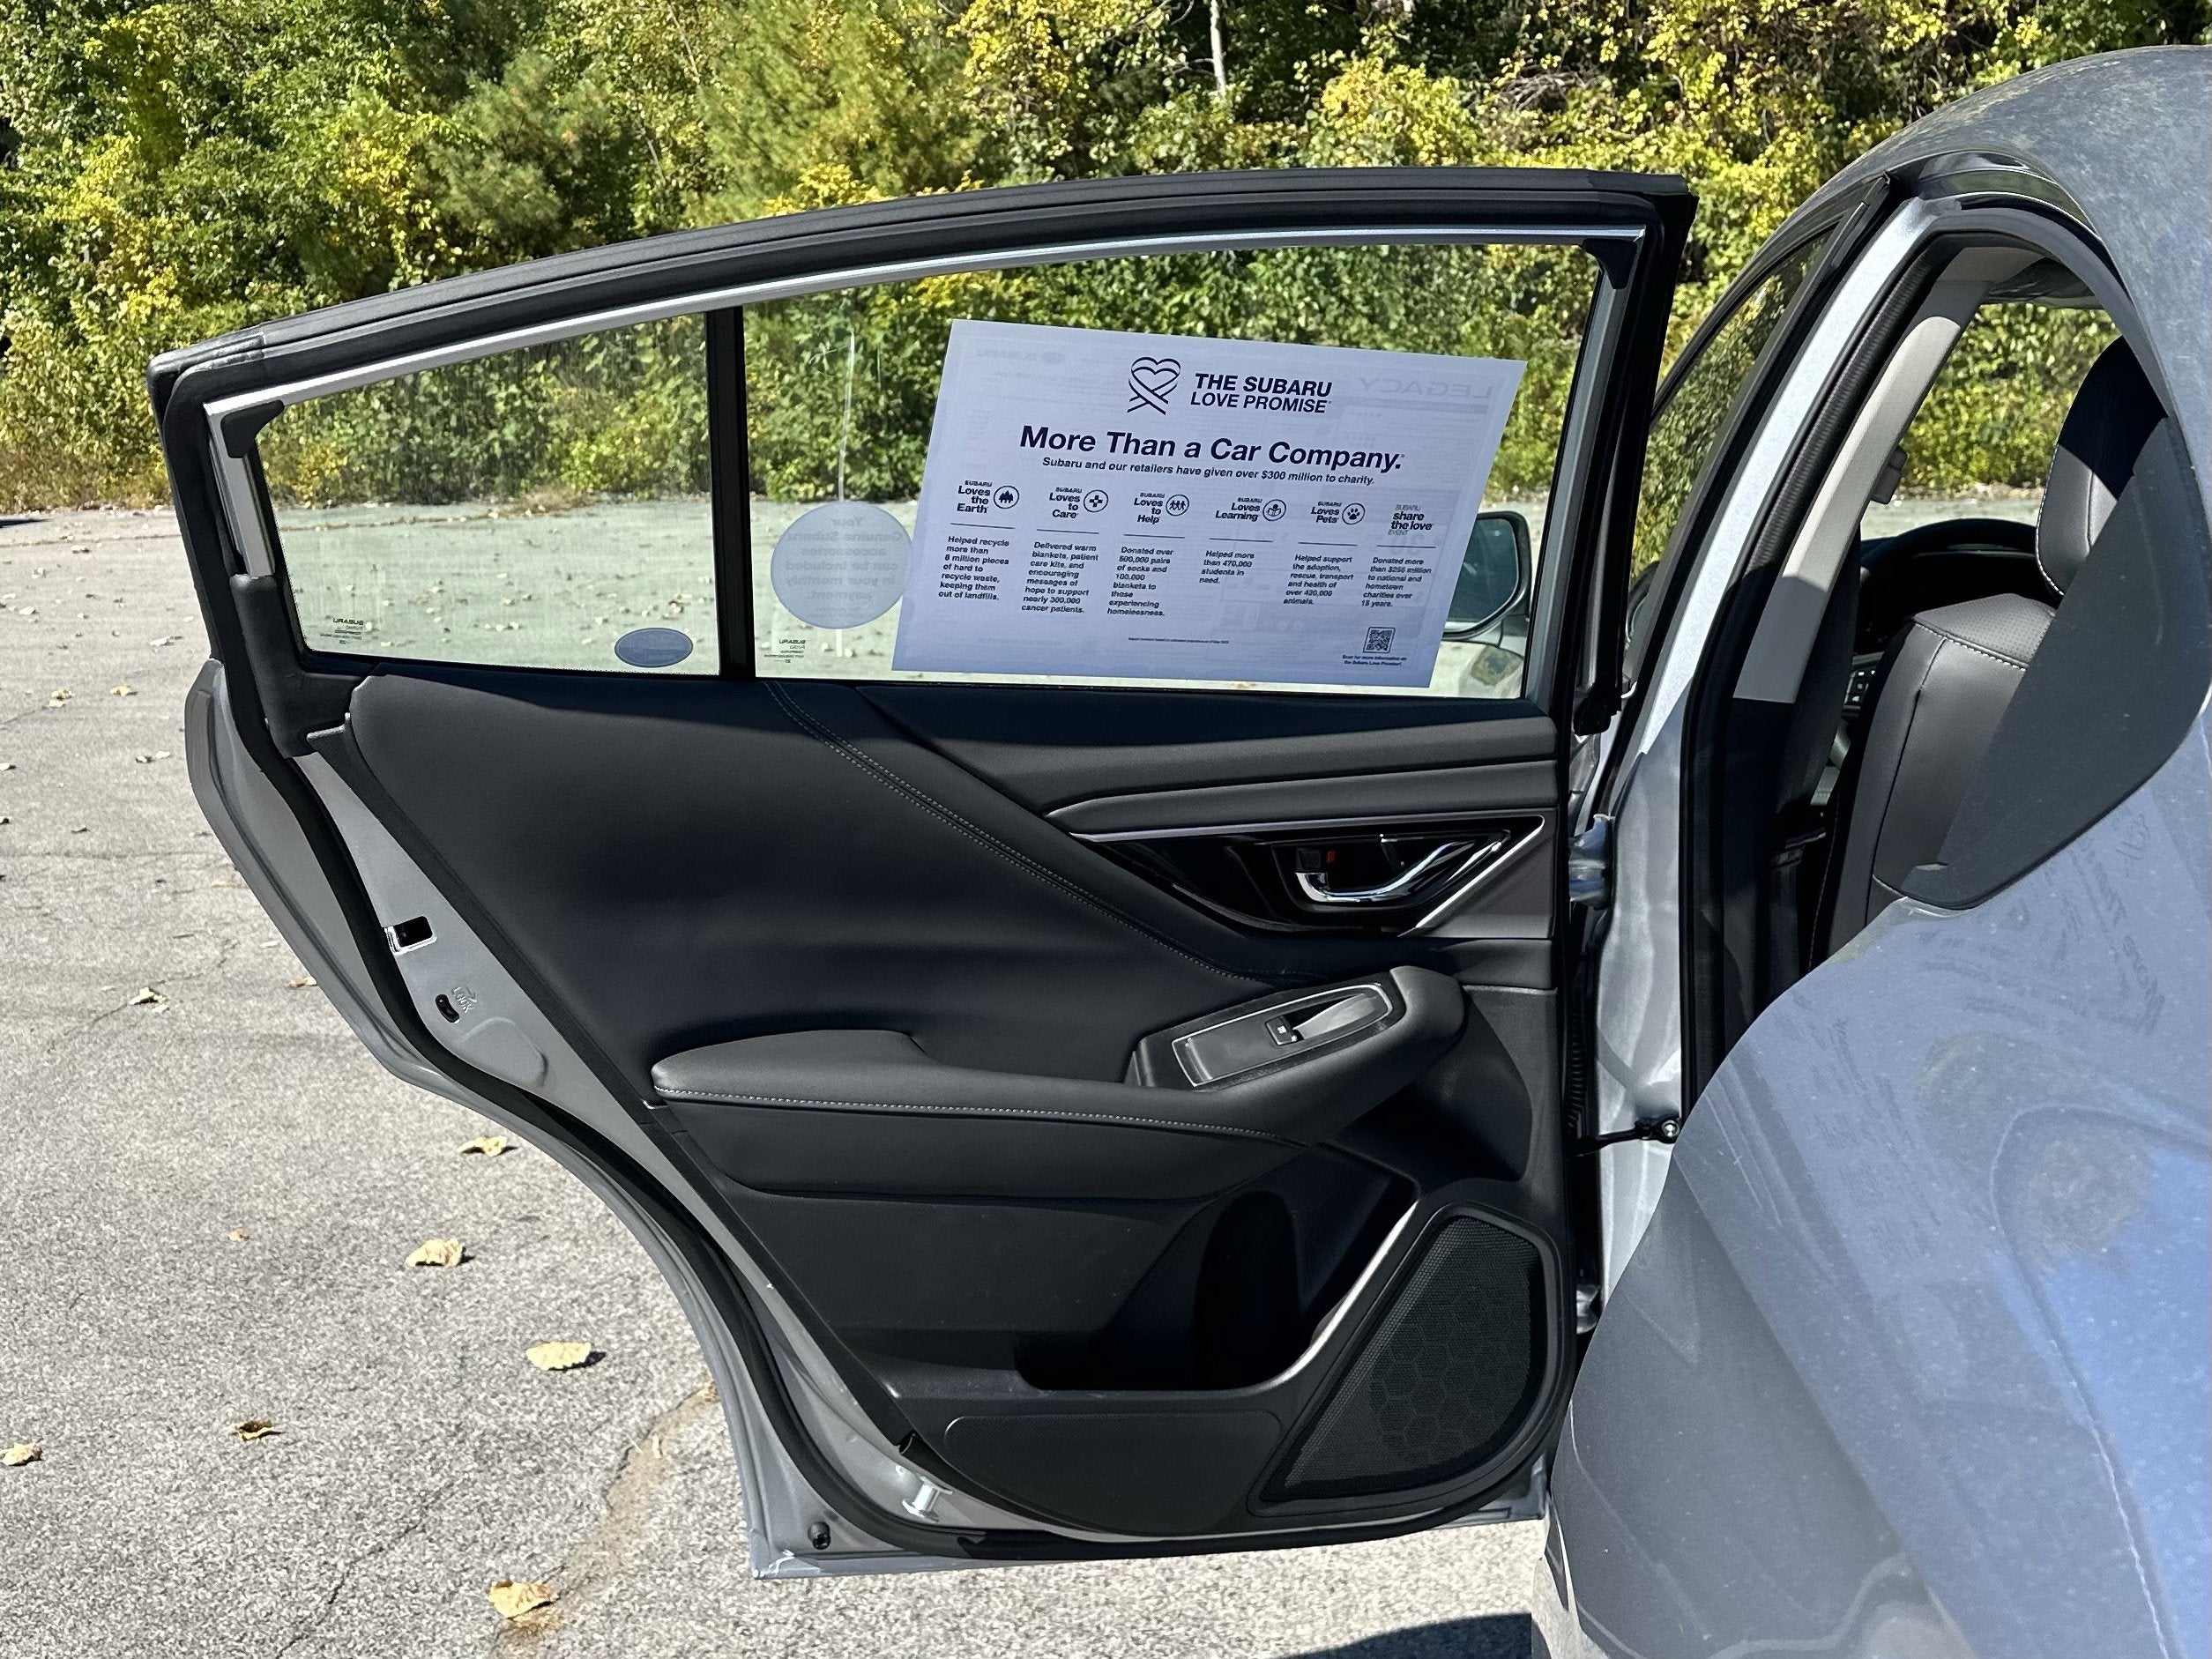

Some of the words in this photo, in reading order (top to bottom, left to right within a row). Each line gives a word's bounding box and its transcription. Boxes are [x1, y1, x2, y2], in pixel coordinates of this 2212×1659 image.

[1195, 373, 1238, 391] THE
[1243, 376, 1332, 397] SUBARU
[1190, 391, 1240, 407] LOVE
[1020, 425, 1096, 452] More
[1106, 431, 1176, 457] Than
[1184, 442, 1202, 458] a
[1210, 437, 1262, 461] Car
[1042, 457, 1082, 469] Subaru
[1085, 461, 1106, 470] and
[1109, 463, 1128, 472] our
[1130, 463, 1173, 474] retailers
[1176, 465, 1201, 475] have
[1203, 467, 1233, 478] given
[1262, 470, 1285, 480] $300
[1287, 472, 1322, 482] million
[1326, 473, 1336, 483] to
[1337, 474, 1374, 486] charity.
[958, 486, 991, 495] Loves
[972, 495, 989, 504] the
[1049, 492, 1080, 502] Loves
[1134, 498, 1163, 507] Loves
[1231, 502, 1260, 511] Loves
[957, 503, 987, 514] Earth
[1311, 506, 1340, 515] Loves
[1052, 510, 1076, 518] Care
[1216, 510, 1258, 522] Learning
[1393, 511, 1425, 521] share
[1137, 515, 1160, 524] Help
[1315, 515, 1337, 524] Pets
[1390, 521, 1410, 530] the
[1410, 521, 1433, 531] love
[948, 536, 978, 545] Helped
[1033, 541, 1073, 551] Delivered
[1121, 546, 1155, 555] Donated
[951, 554, 980, 563] million
[1032, 551, 1069, 560] blankets,
[1070, 553, 1099, 562] patient
[1205, 550, 1233, 559] Helped
[1294, 554, 1322, 562] Helped
[1322, 555, 1352, 564] support
[1372, 556, 1404, 565] Donated
[1028, 569, 1079, 578] encouraging
[1319, 572, 1354, 581] transport
[941, 573, 972, 582] recycle
[973, 574, 1000, 584] waste,
[1026, 577, 1068, 586] messages
[940, 581, 972, 591] keeping
[964, 591, 999, 600] landfills.
[1024, 586, 1046, 595] hope
[1058, 588, 1090, 597] support
[1108, 599, 1159, 609] experiencing
